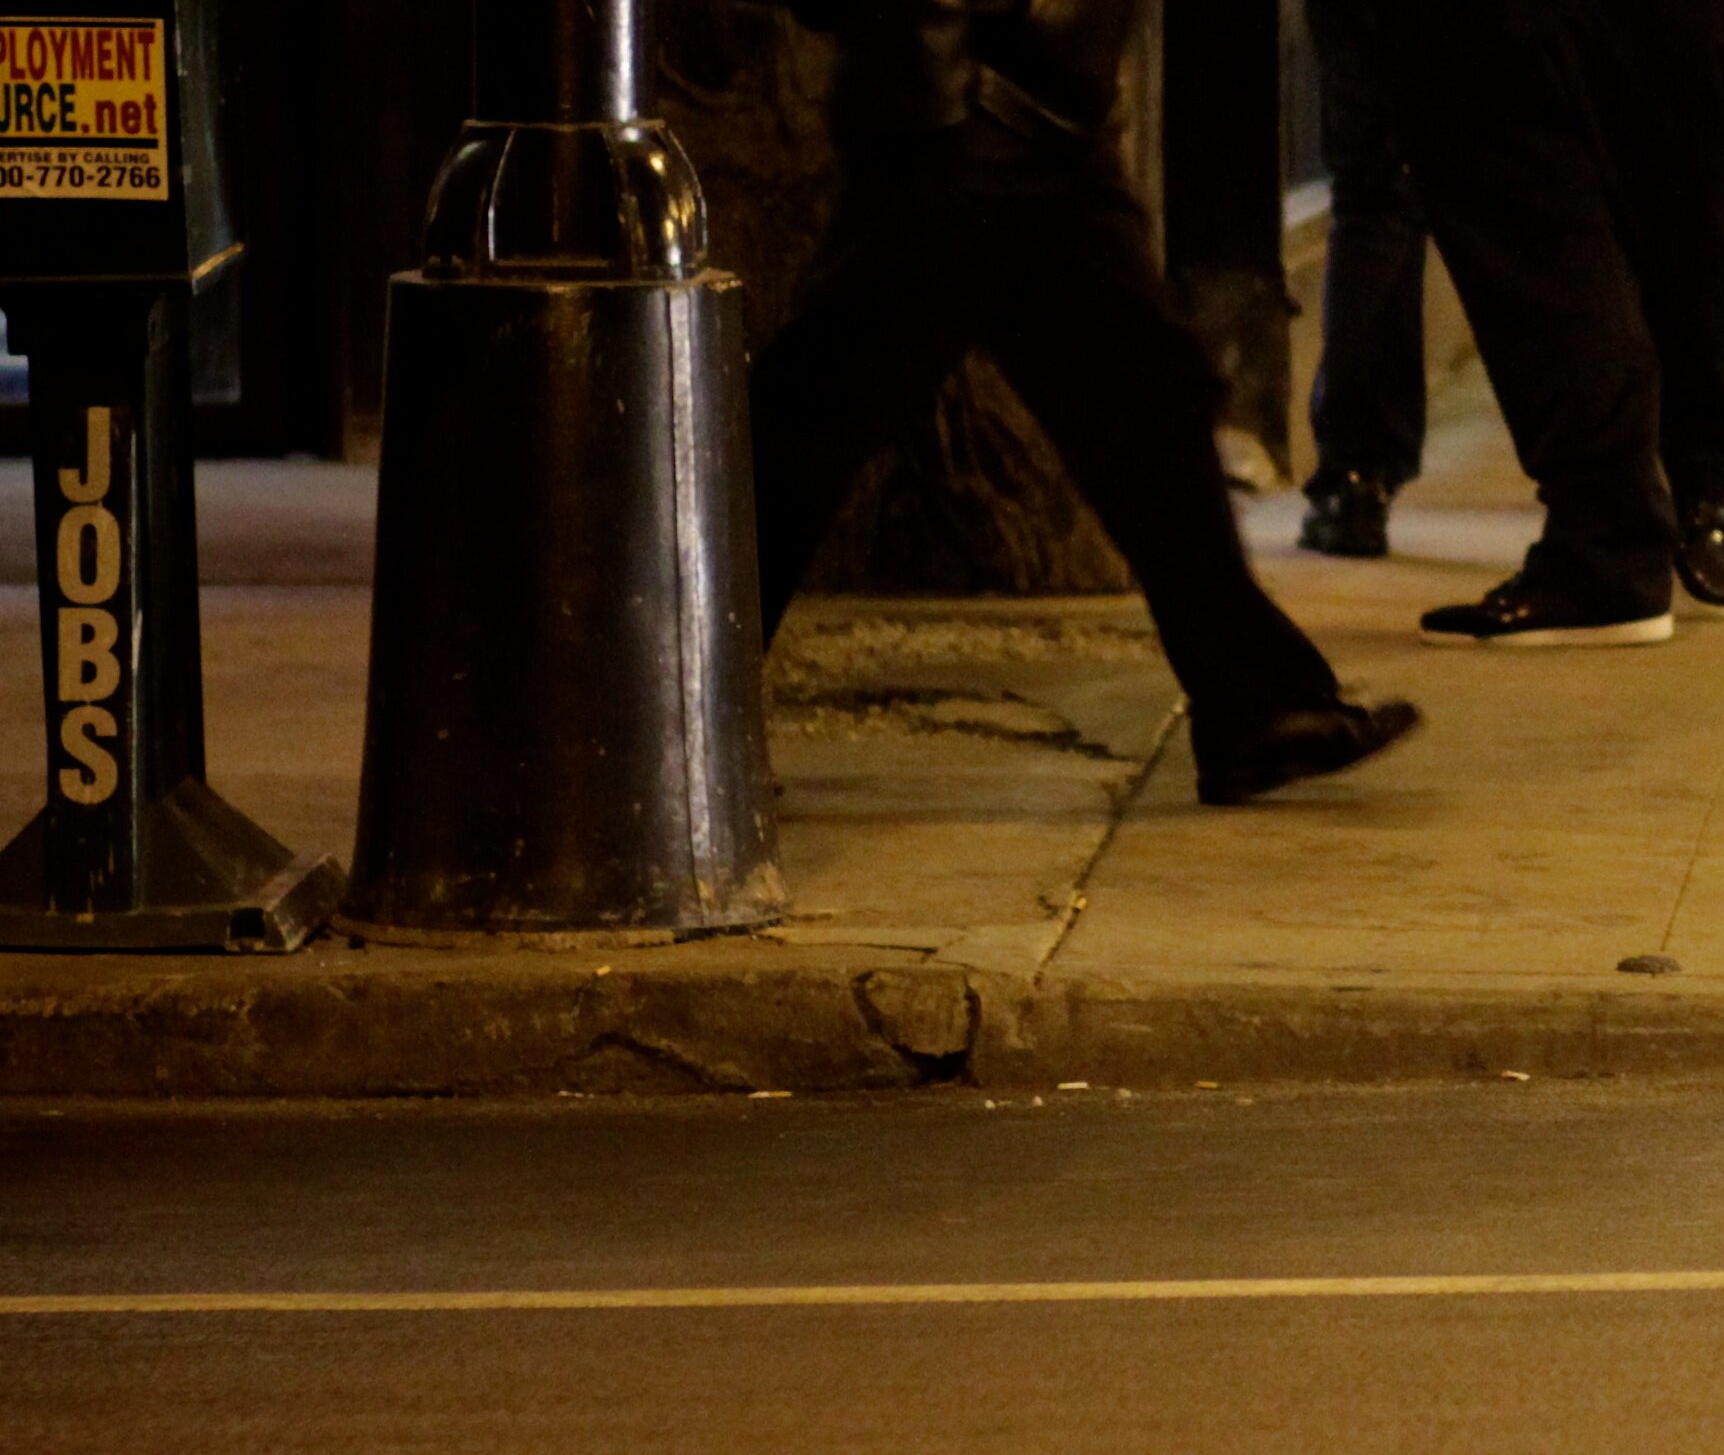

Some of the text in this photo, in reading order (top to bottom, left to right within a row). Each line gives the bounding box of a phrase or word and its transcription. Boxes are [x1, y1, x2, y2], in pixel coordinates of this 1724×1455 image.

[58, 152, 78, 163] BY
[83, 152, 150, 164] CALLING
[56, 406, 122, 805] JOBS
